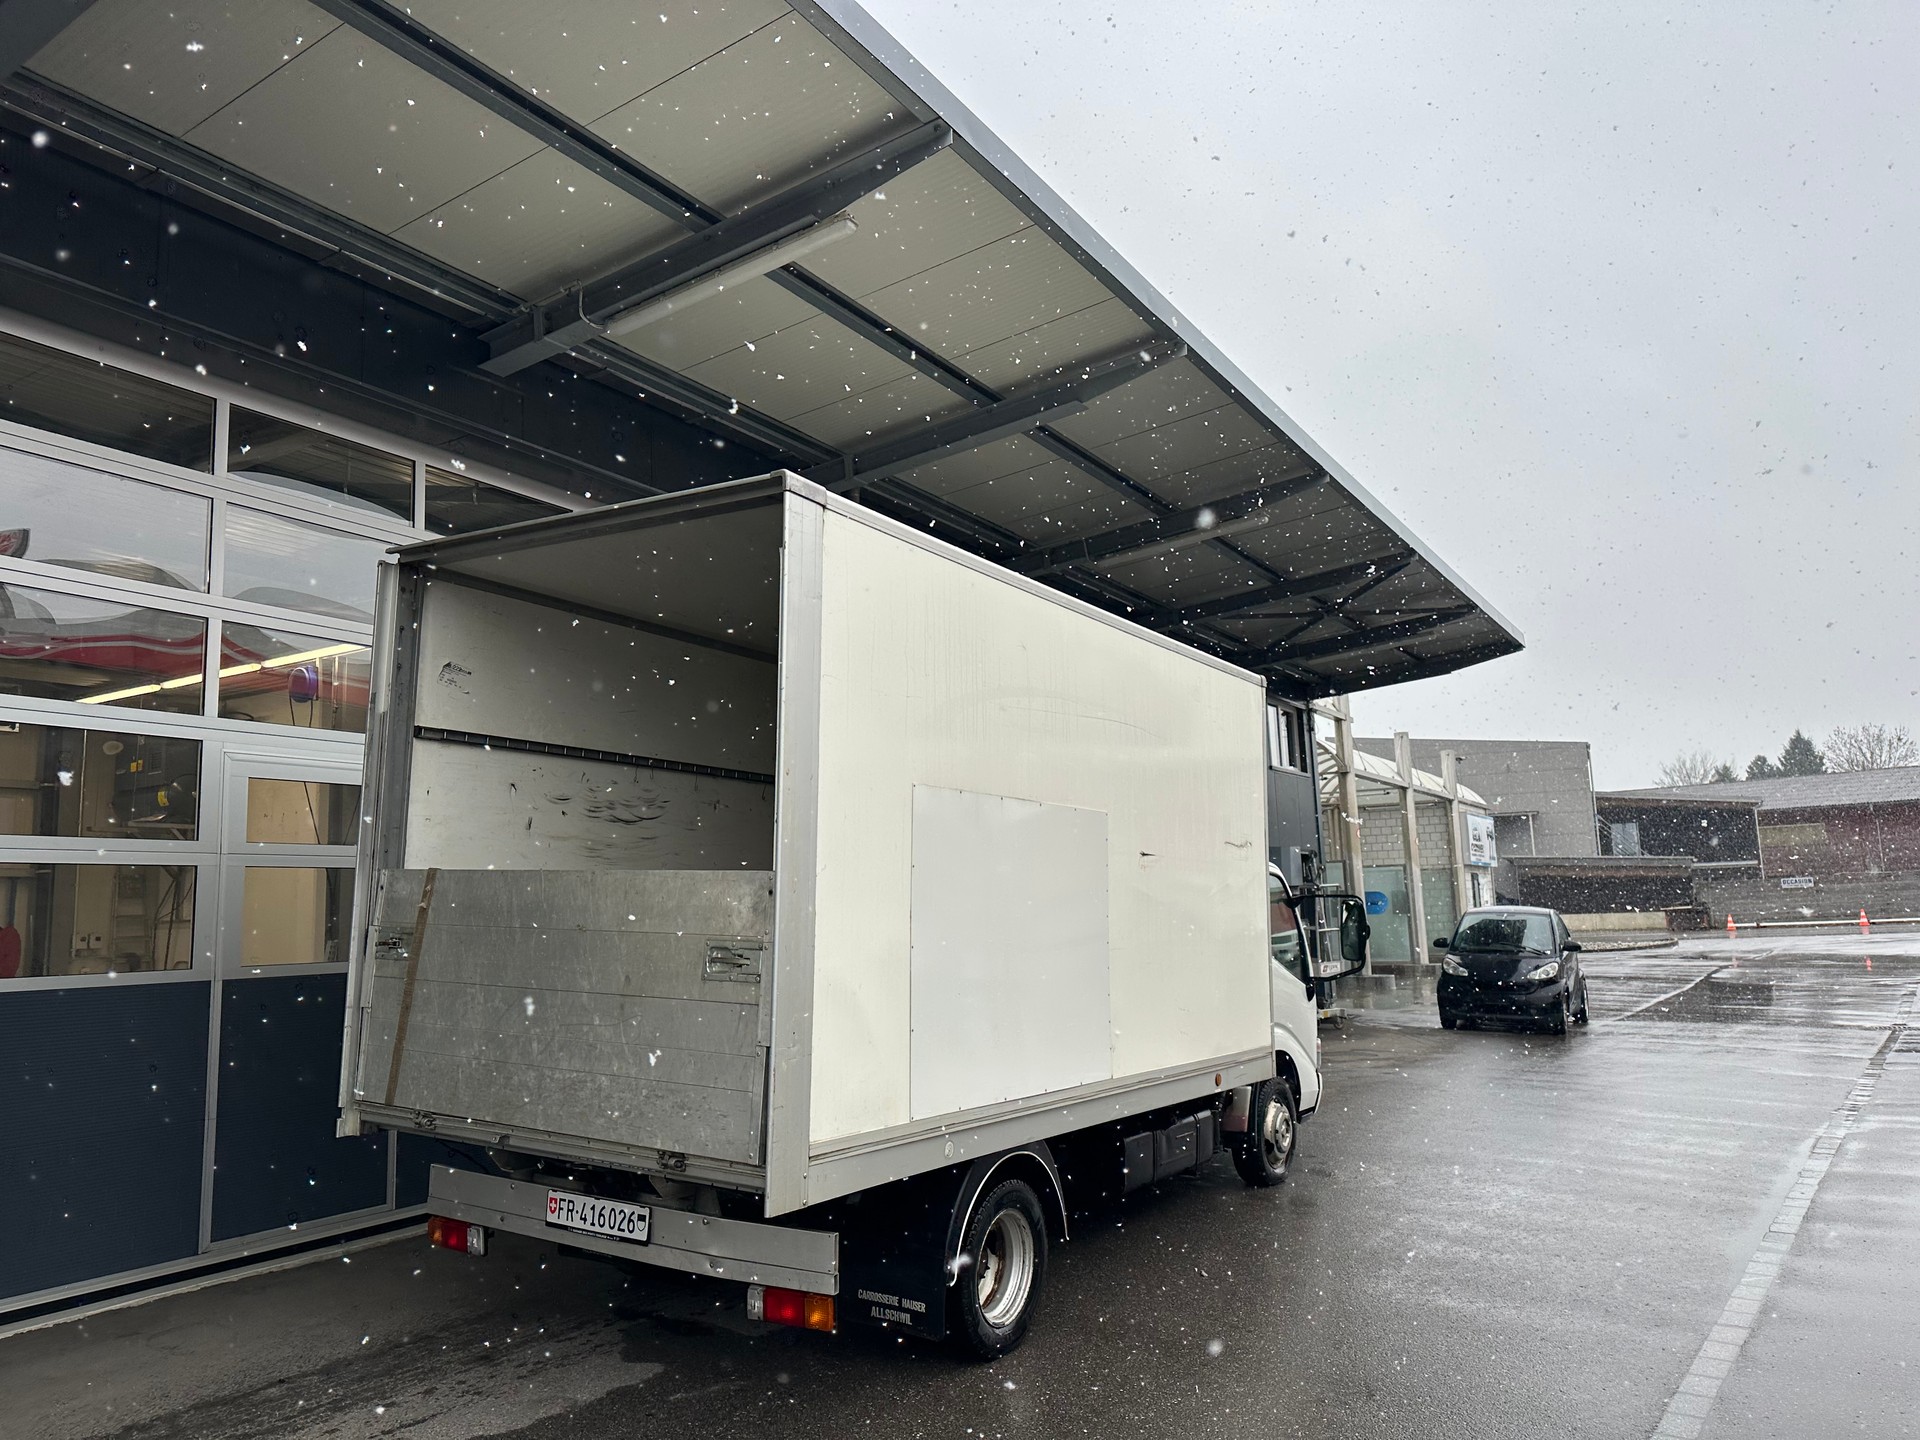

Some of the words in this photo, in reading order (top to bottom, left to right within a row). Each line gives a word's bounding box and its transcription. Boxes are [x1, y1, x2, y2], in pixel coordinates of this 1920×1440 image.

[857, 1289, 899, 1306] CARROSSERIE
[901, 1298, 926, 1313] HAUSER
[870, 1306, 912, 1325] ALLSCHWIL
